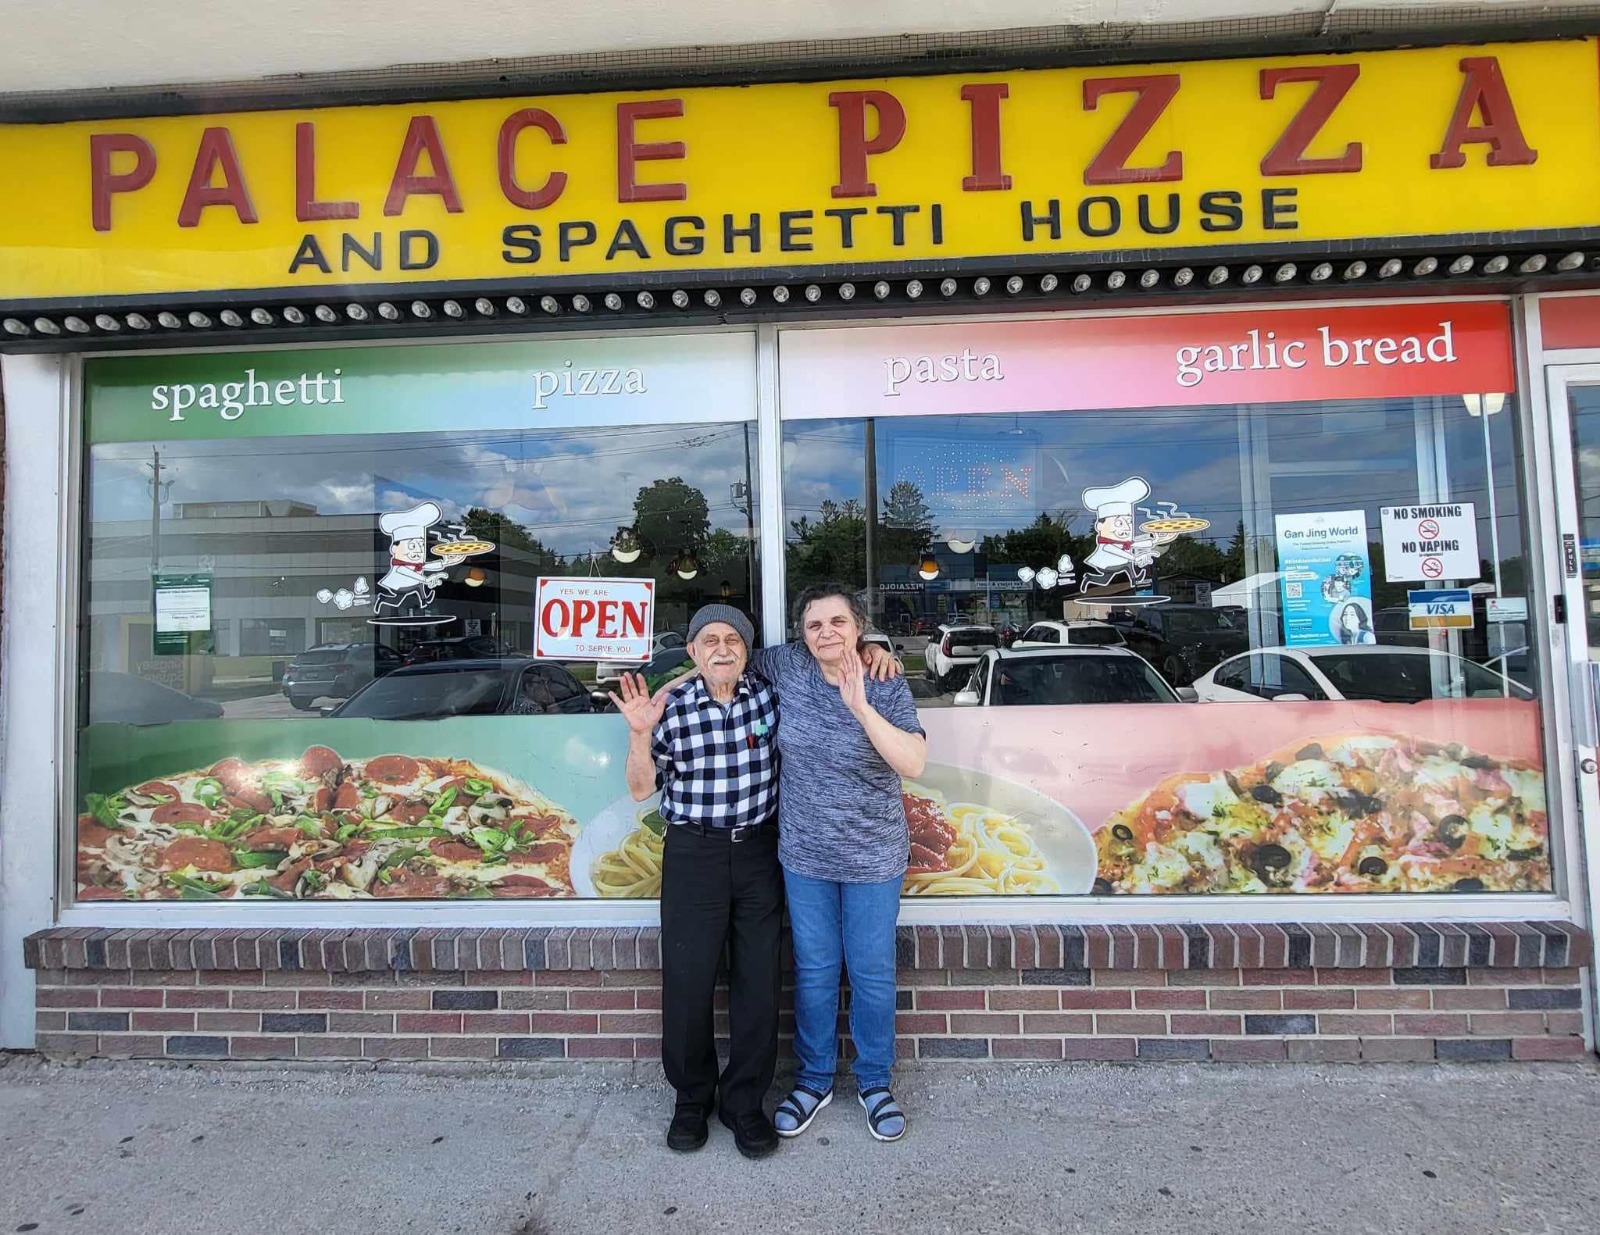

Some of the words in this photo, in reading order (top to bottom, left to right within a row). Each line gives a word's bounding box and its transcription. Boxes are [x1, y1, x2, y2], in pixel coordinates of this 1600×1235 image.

[90, 98, 688, 231] PALACE
[827, 56, 1539, 199] PIZZA
[287, 229, 440, 274] AND
[501, 203, 943, 264] SPAGHETTI
[1020, 187, 1299, 242] HOUSE
[883, 347, 1005, 397] pasta
[1174, 328, 1307, 388] garlic
[1317, 321, 1459, 368] bread
[151, 368, 345, 421] spaghetti
[531, 359, 648, 409] pizza
[897, 465, 1032, 499] OPEN
[1393, 507, 1408, 520] NO
[1411, 505, 1462, 519] SMOKING
[1284, 529, 1304, 539] Gan
[1305, 527, 1327, 539] Jing
[1328, 526, 1359, 536] World
[1401, 541, 1417, 553] NO
[1418, 539, 1460, 553] VAPING
[559, 588, 575, 596] YES
[577, 588, 590, 596] WE
[593, 589, 610, 597] ARE
[1426, 603, 1456, 615] VISA
[541, 598, 648, 638] OPEN
[575, 644, 585, 652] TO
[617, 645, 631, 653] YOU
